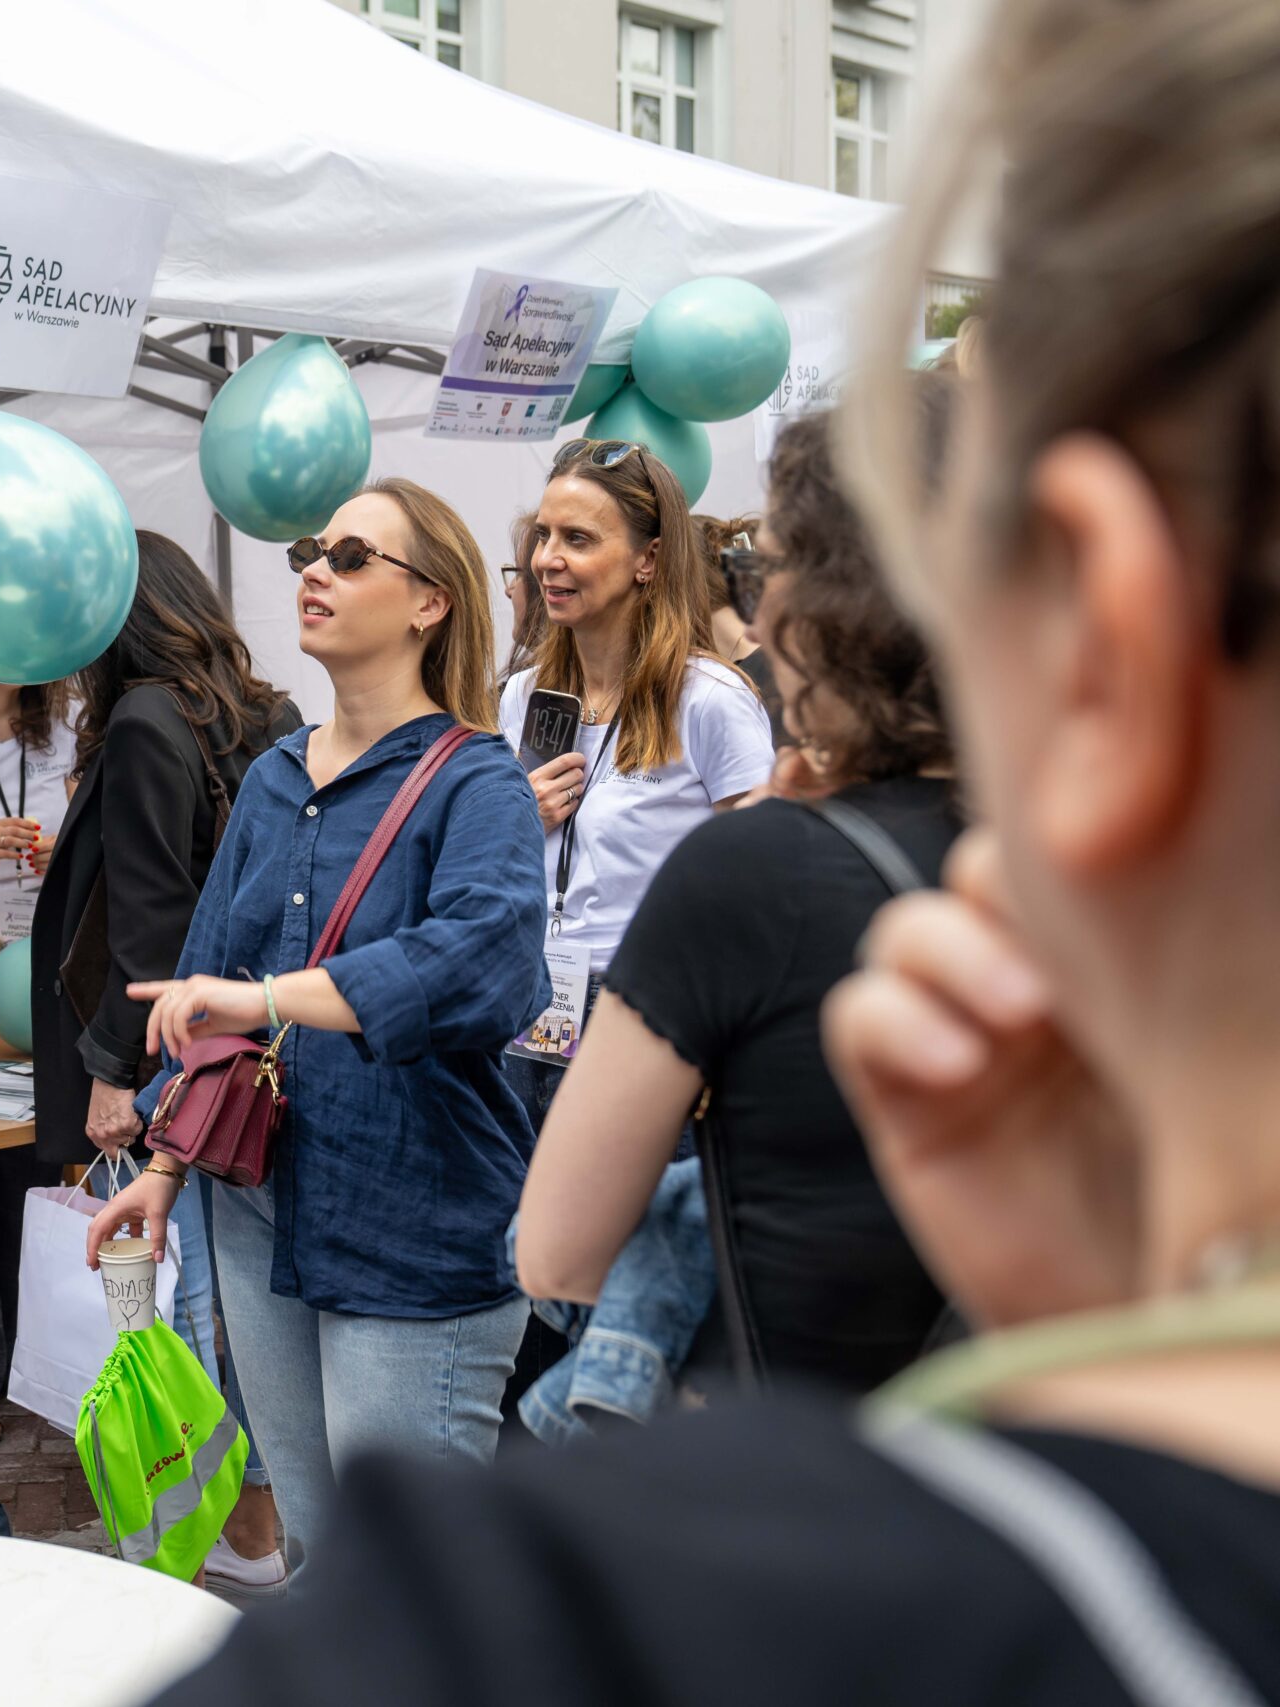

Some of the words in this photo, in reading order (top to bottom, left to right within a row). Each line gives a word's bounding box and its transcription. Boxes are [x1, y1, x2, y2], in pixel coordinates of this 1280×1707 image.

[22, 256, 63, 285] SĄD
[17, 283, 137, 318] APELACYJNY
[14, 311, 24, 320] w
[26, 309, 80, 329] Warszawie
[483, 330, 511, 352] Sąd
[510, 333, 575, 358] Apelacyjny
[485, 359, 497, 372] w
[499, 357, 560, 377] Warszawie
[797, 365, 819, 385] SĄD
[797, 384, 843, 401] APELACY
[529, 707, 573, 754] 13:47
[615, 773, 662, 785] AELACYJNY
[553, 991, 569, 1002] TNER
[551, 1001, 575, 1013] RZENIA
